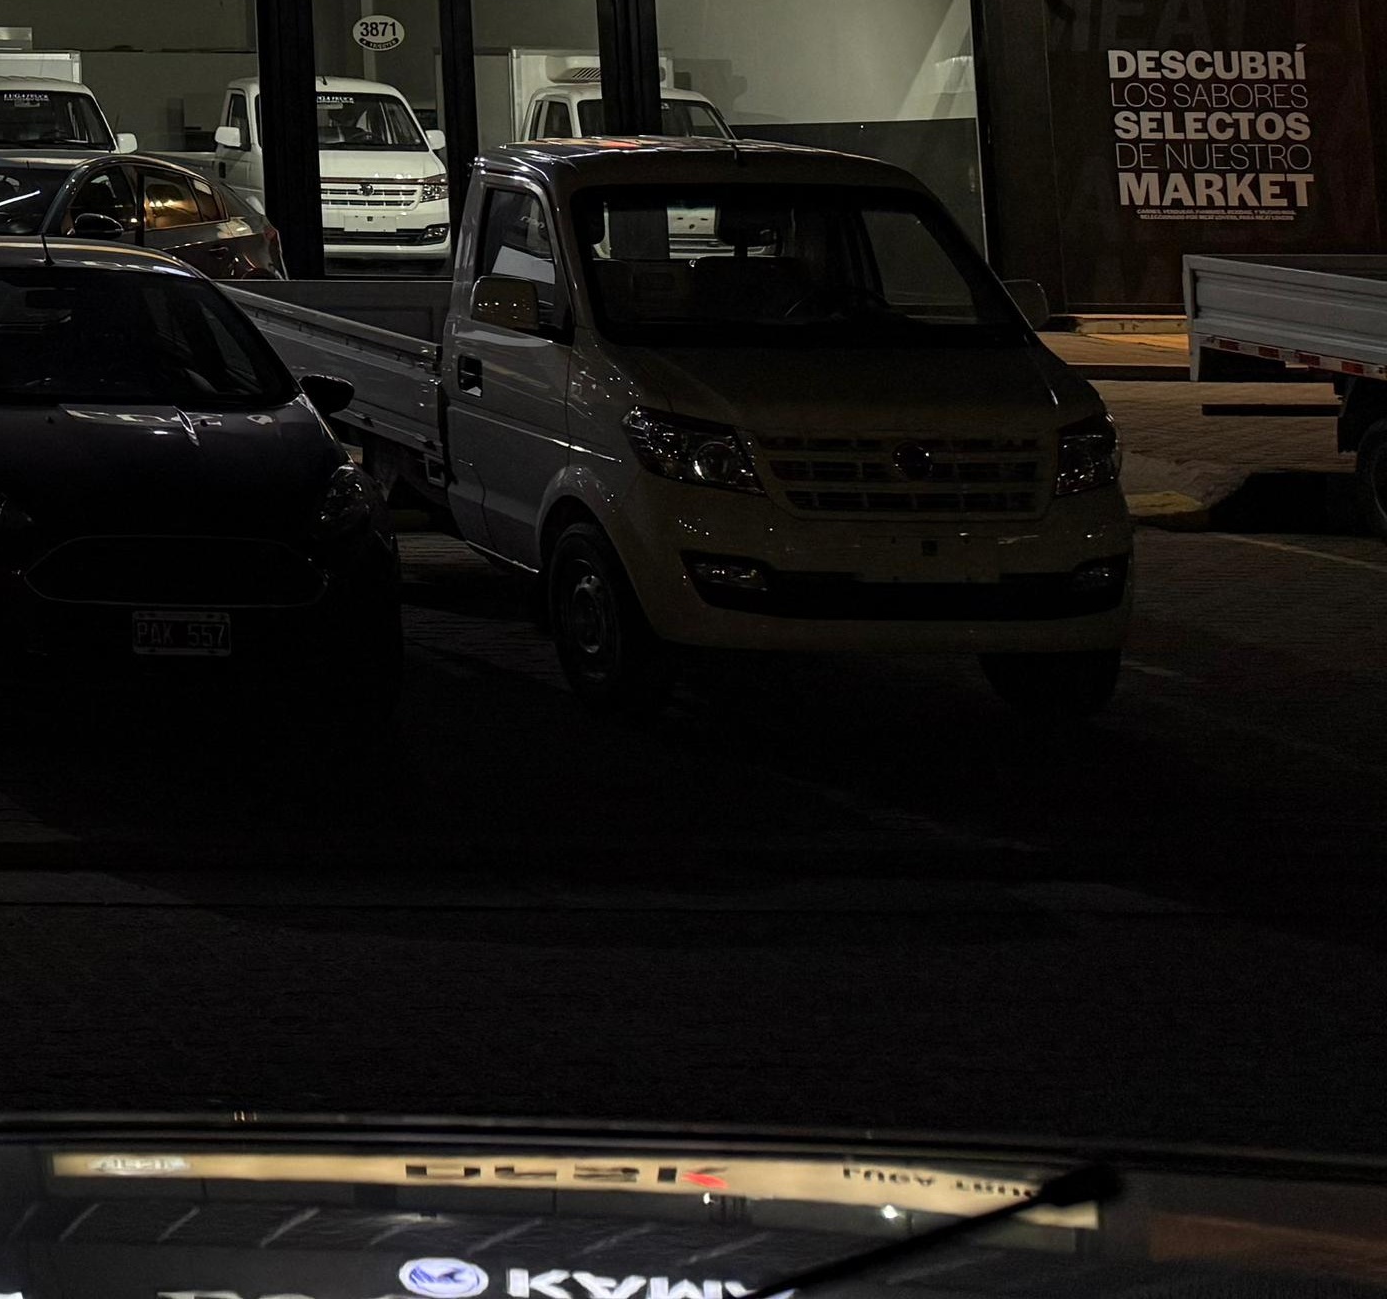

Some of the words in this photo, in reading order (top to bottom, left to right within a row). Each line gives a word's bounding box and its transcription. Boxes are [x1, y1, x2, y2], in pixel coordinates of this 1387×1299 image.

[359, 21, 396, 37] 3871
[1107, 43, 1307, 80] DESCUBRÍ
[1110, 82, 1167, 108] LOS
[1173, 83, 1309, 109] SABORES
[1114, 111, 1312, 141] SELECTOS
[1115, 143, 1159, 169] DE
[1165, 143, 1312, 171] NUESTRO
[1118, 172, 1315, 207] MARKET
